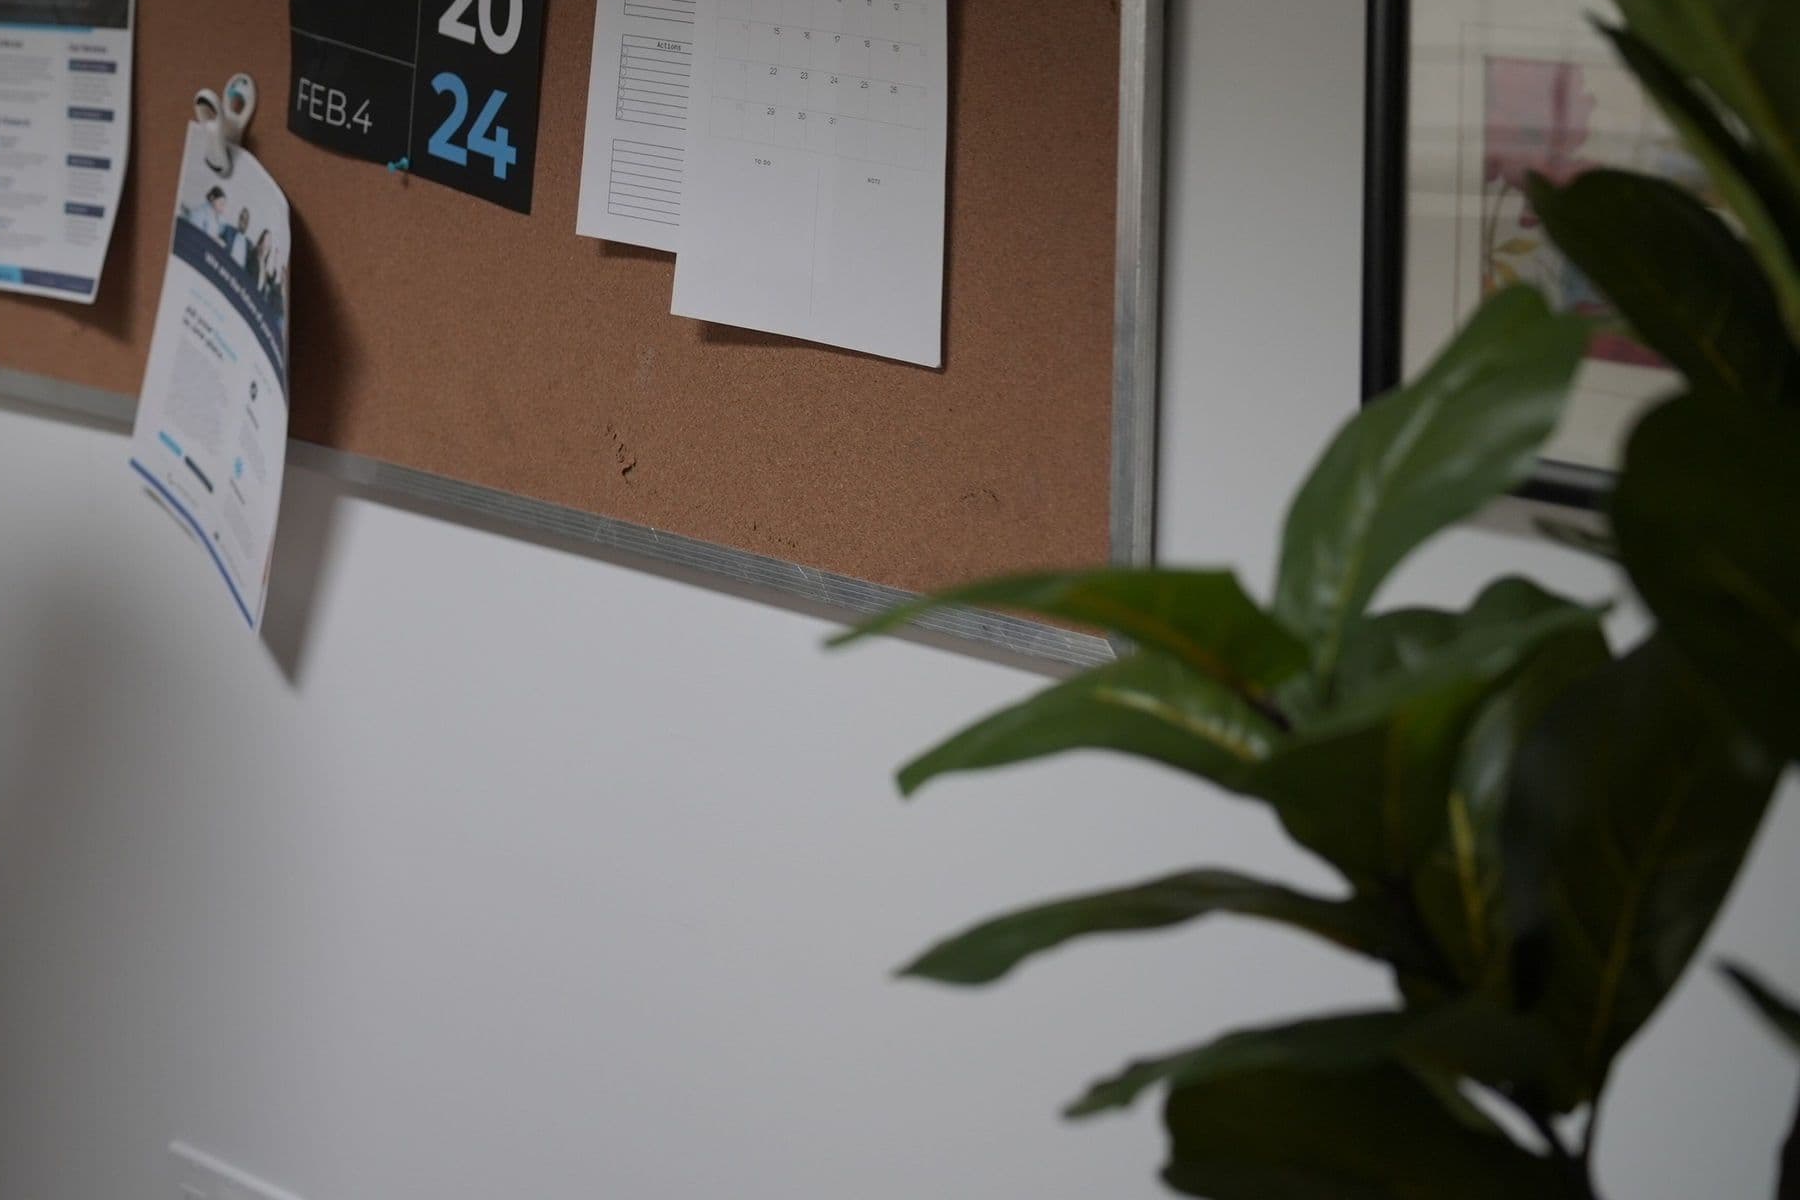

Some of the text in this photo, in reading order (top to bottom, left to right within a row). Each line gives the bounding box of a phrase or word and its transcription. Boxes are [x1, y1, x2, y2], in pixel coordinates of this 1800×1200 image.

[657, 41, 681, 51] Actions
[297, 76, 373, 135] FEB.4
[427, 71, 517, 180] 24
